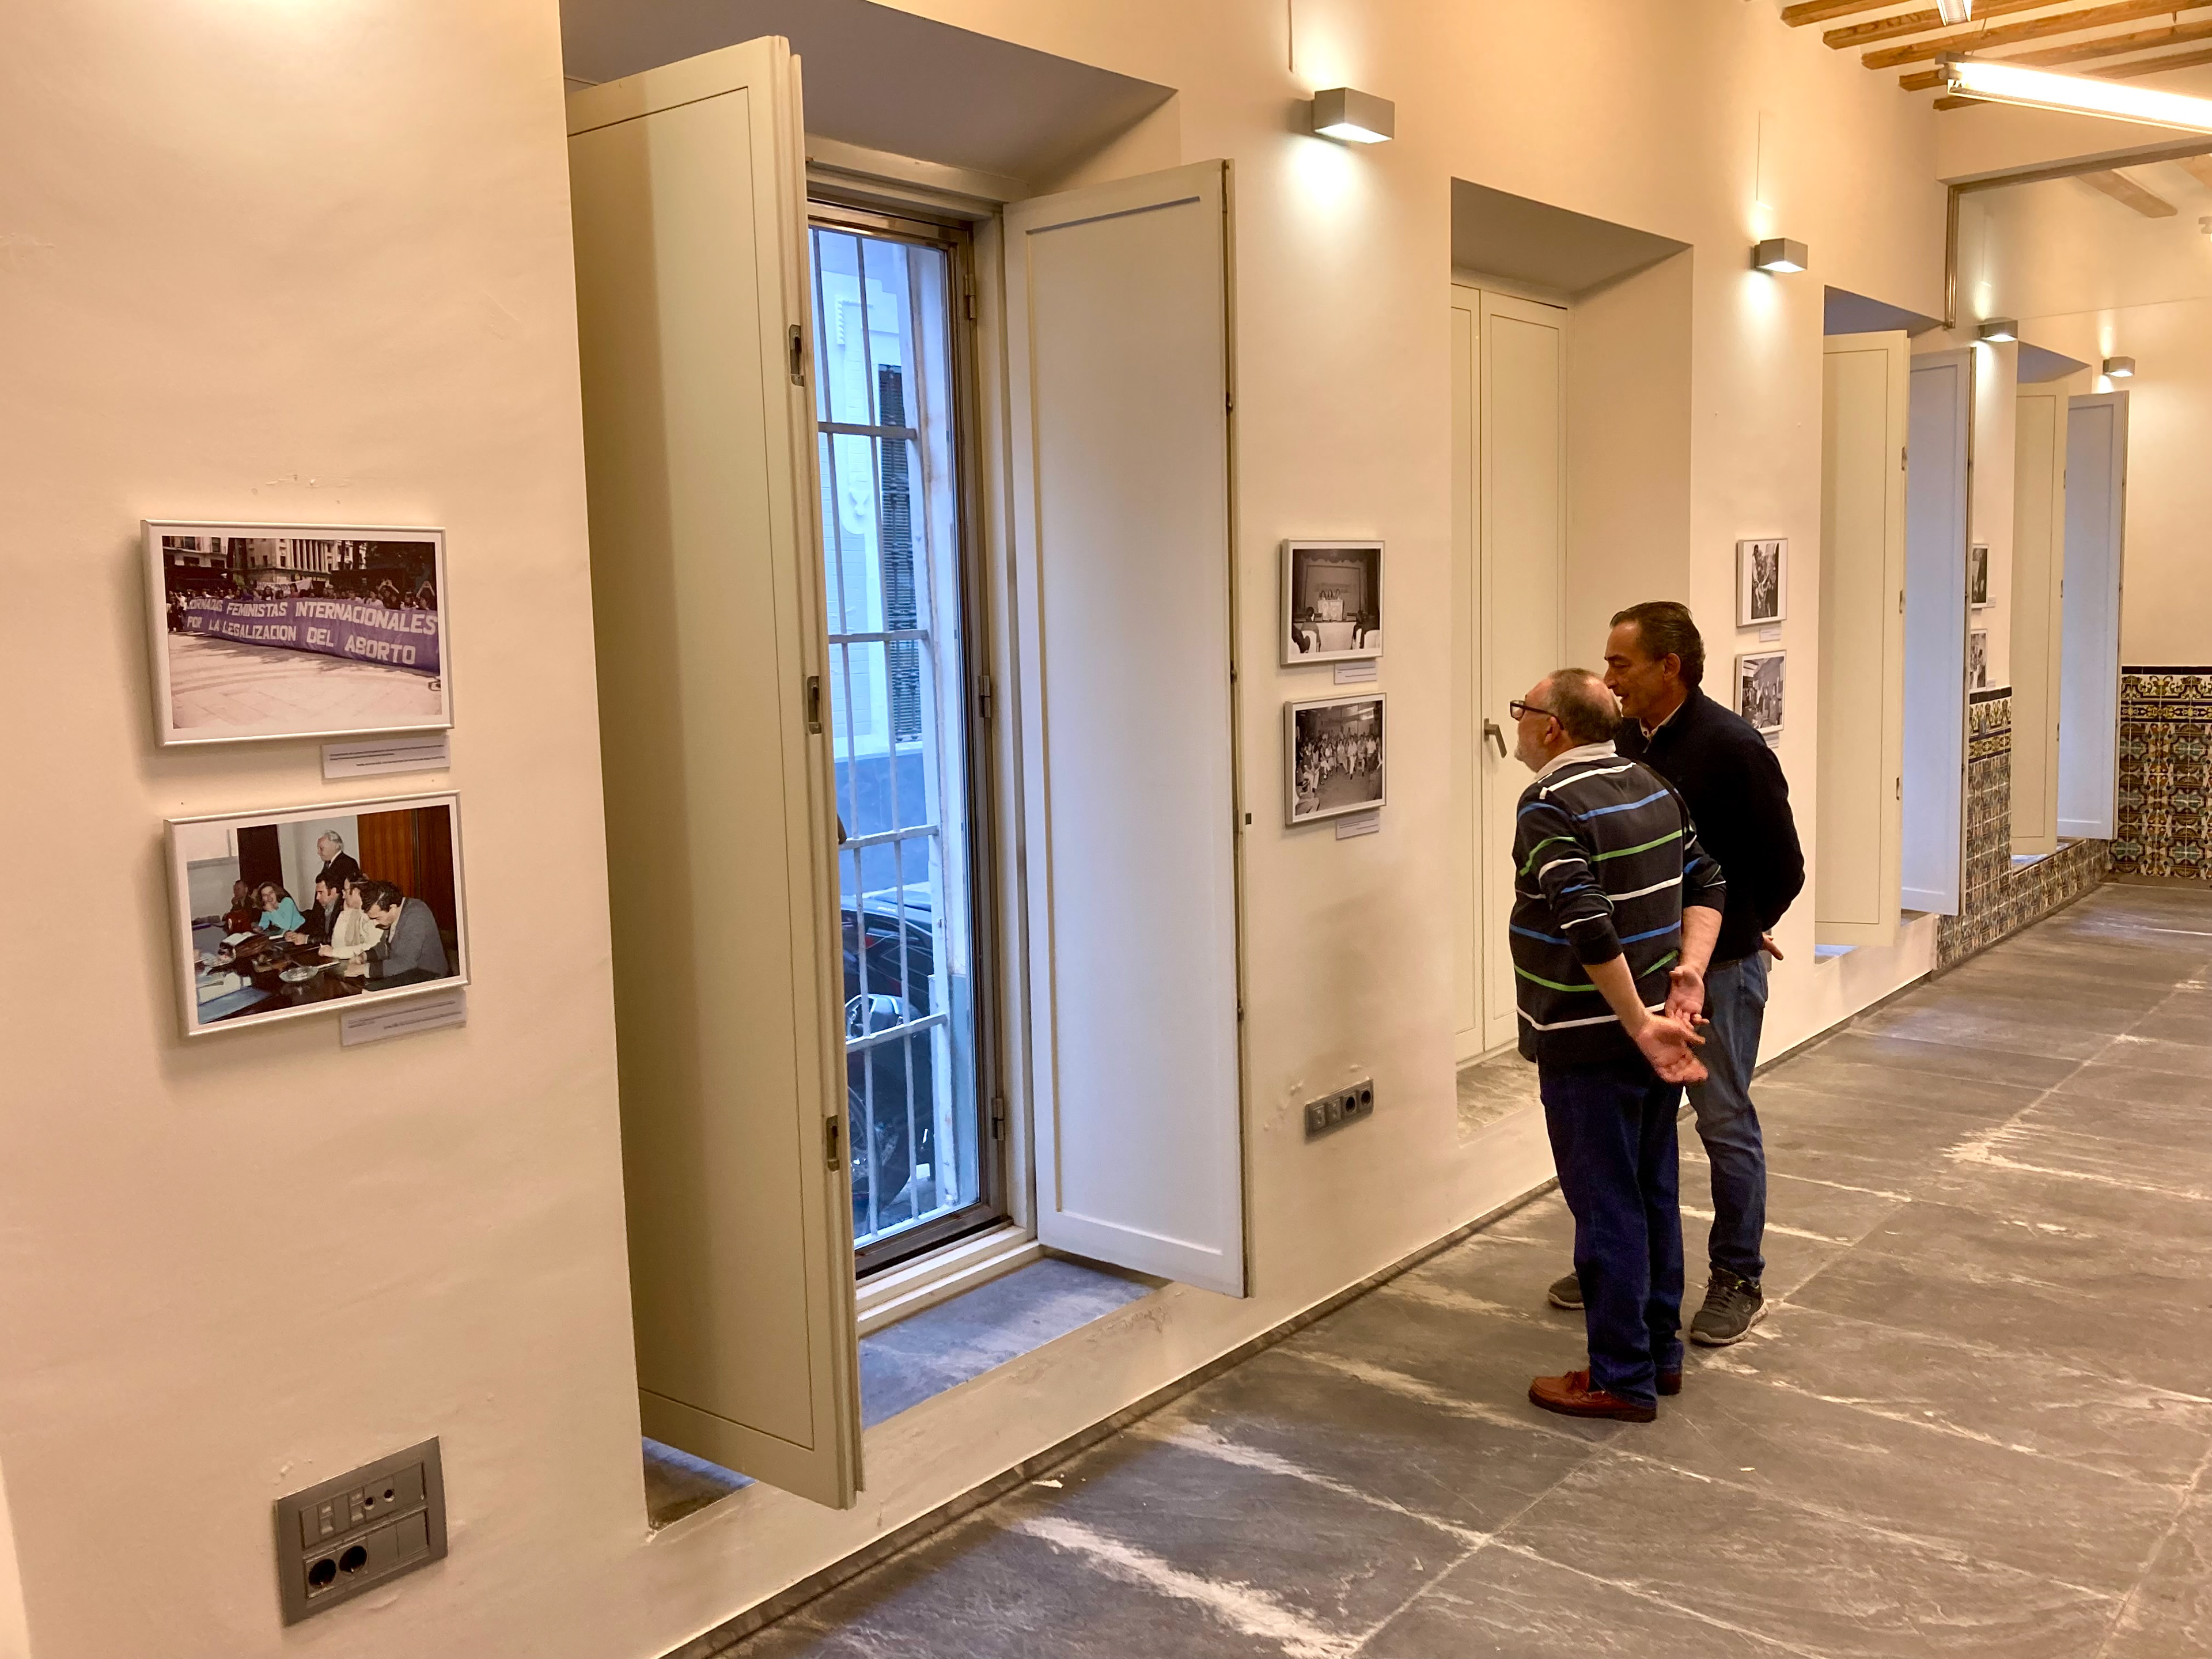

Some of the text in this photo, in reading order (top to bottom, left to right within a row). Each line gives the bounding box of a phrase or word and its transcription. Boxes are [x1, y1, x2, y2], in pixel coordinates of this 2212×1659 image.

[226, 601, 288, 617] FEMINISTAS
[296, 601, 438, 635] INTERNACIONALES
[187, 616, 415, 665] POR LA LEGALIZACION DEL ABORTO
